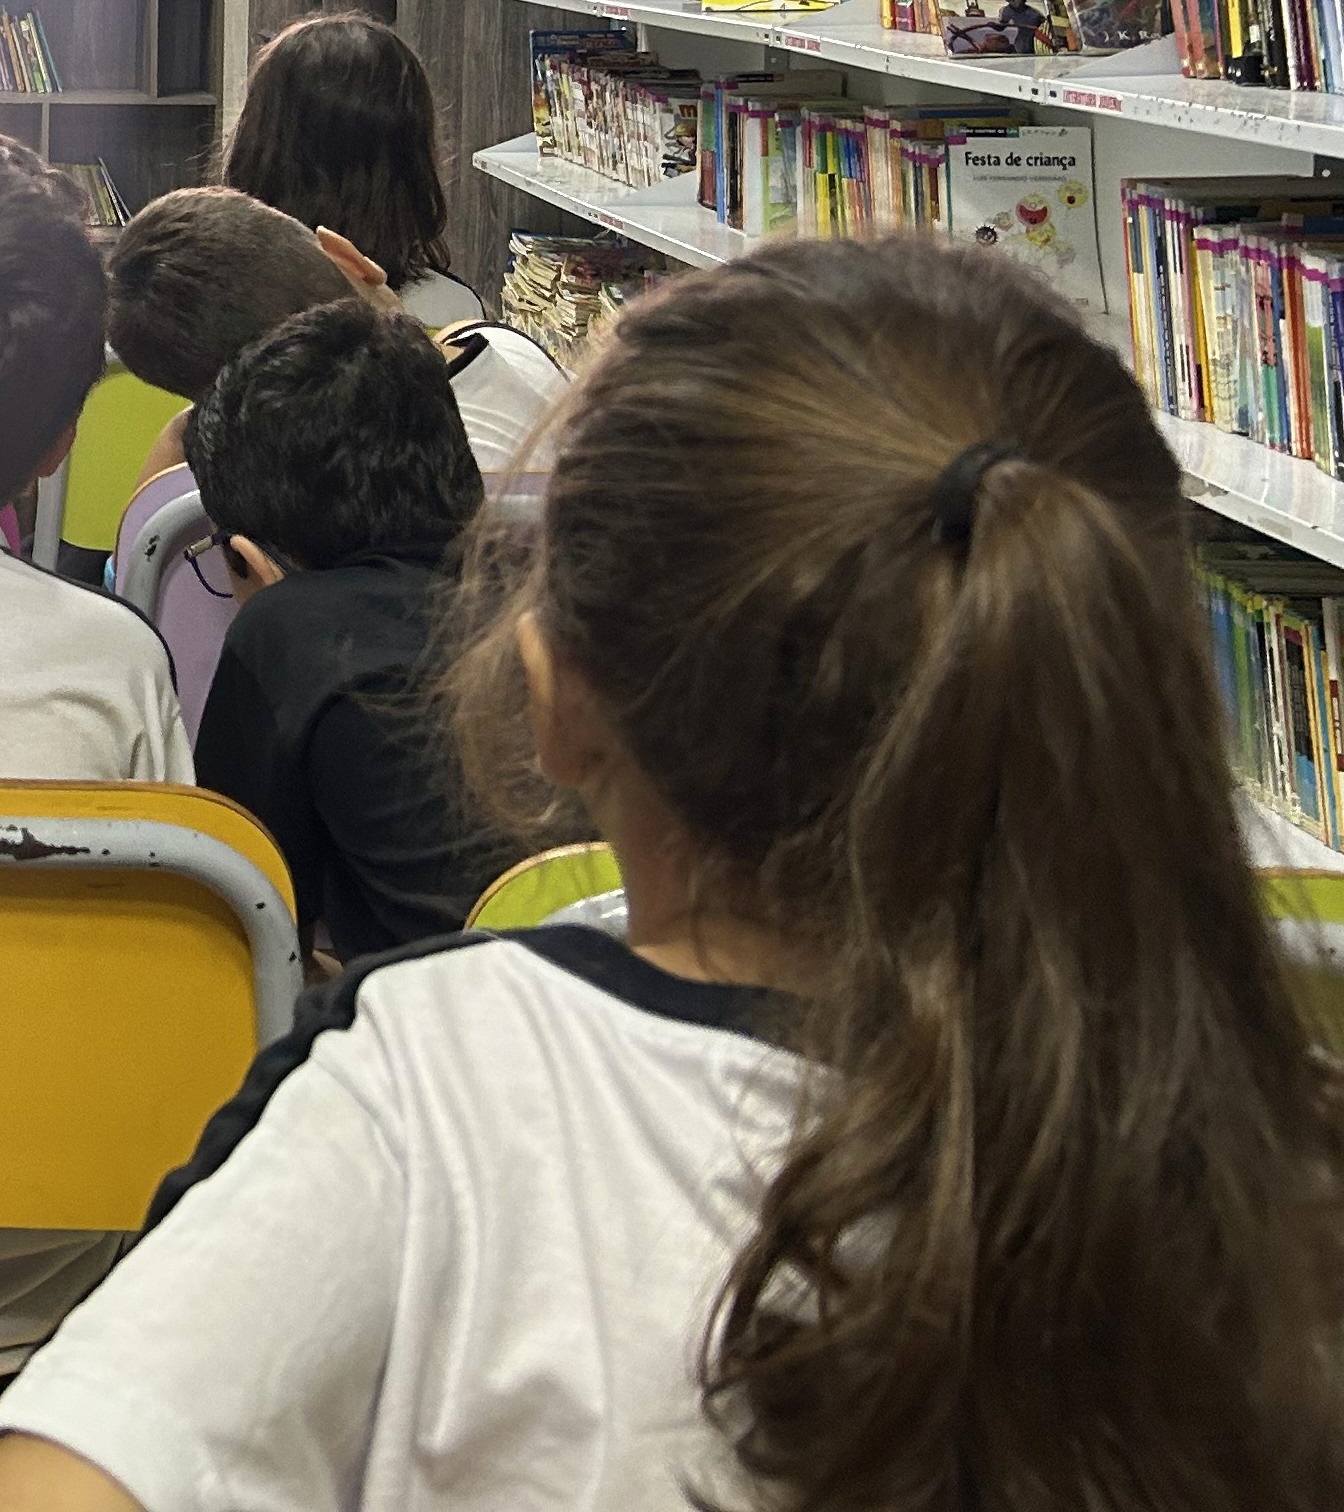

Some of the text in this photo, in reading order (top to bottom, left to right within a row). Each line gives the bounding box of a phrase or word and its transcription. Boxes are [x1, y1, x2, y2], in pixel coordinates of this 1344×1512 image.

[965, 152, 1076, 170] Festa de criança
